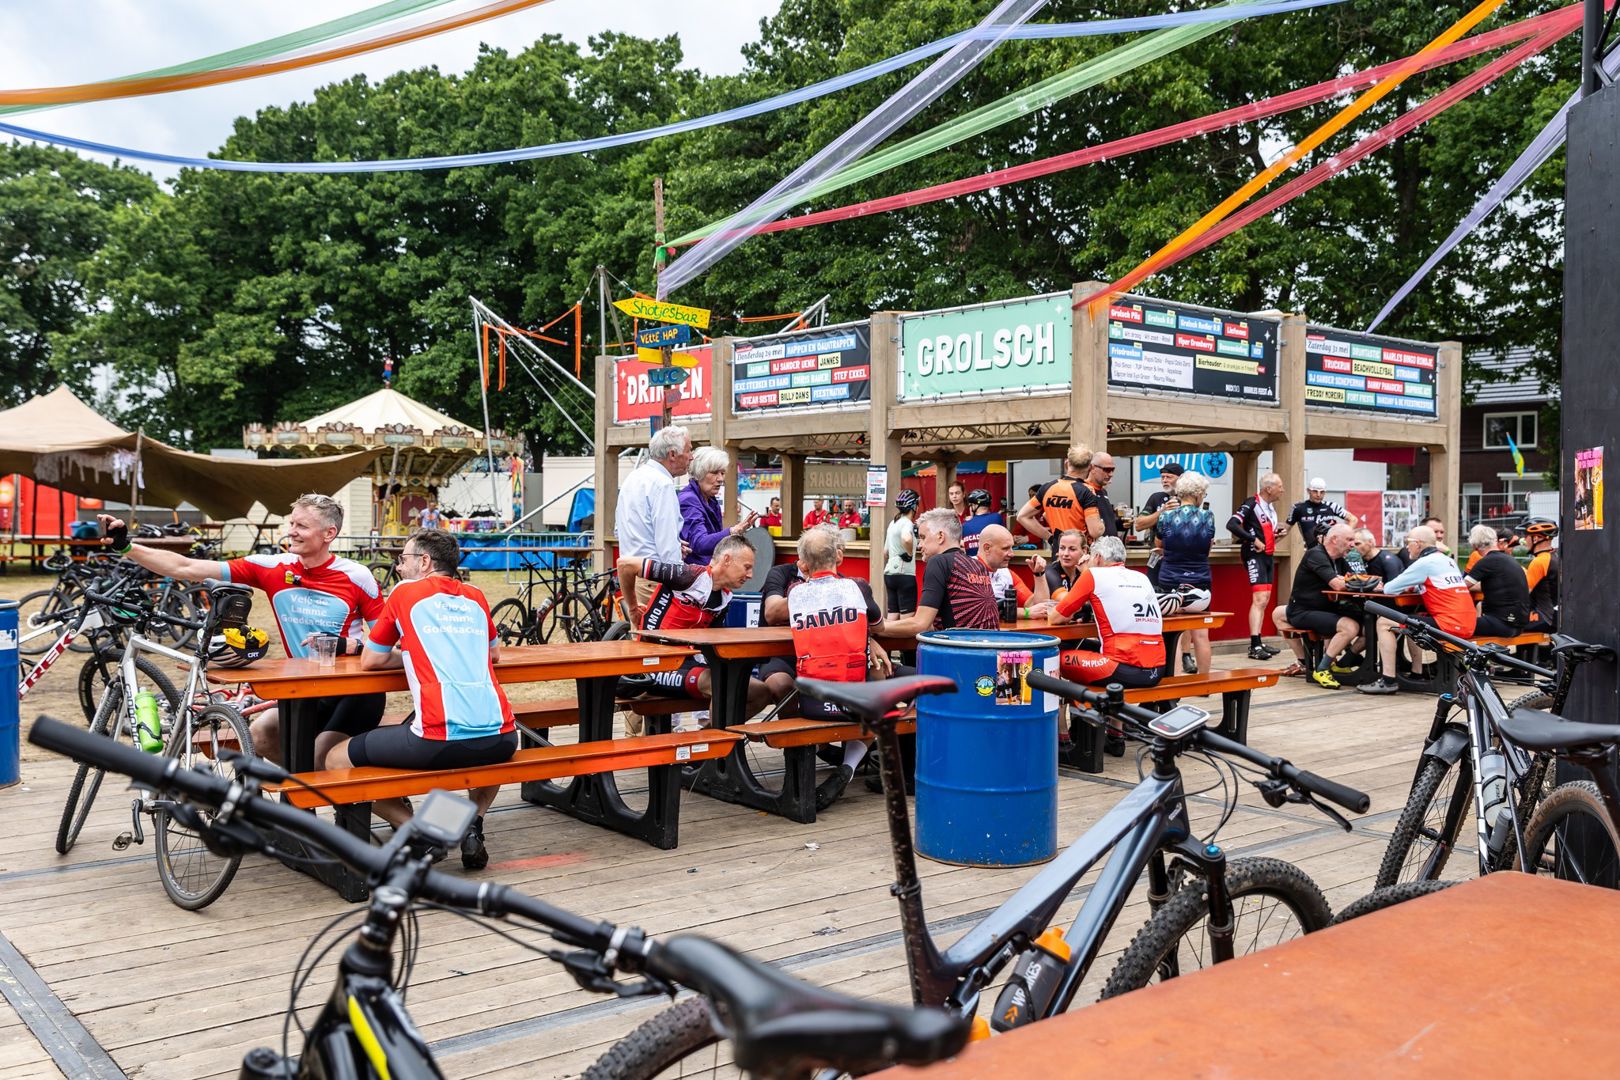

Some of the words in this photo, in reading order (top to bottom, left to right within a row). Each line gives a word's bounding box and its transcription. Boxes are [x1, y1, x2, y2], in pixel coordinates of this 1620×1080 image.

[1112, 309, 1130, 320] Grolsch
[662, 328, 678, 340] HAP
[917, 321, 1056, 377] GROLSCH
[1308, 340, 1331, 353] Zaterdag
[737, 350, 764, 361] Donderdag
[772, 348, 783, 356] mei
[820, 356, 840, 366] JANNES
[834, 371, 848, 380] STEF
[1354, 362, 1393, 377] BEACHVOLLEYBAL
[628, 367, 702, 405] DRINEN
[780, 391, 795, 400] BILLY
[795, 390, 810, 400] DANS
[1306, 388, 1324, 398] FREDDY
[1326, 390, 1344, 400] MOREIRA
[1046, 494, 1074, 509] KTM
[292, 606, 328, 616] Lamme
[646, 592, 670, 631] AMO.NL
[1132, 602, 1159, 618] 2M
[1064, 655, 1080, 666] 2M
[1024, 961, 1042, 991] IKES
